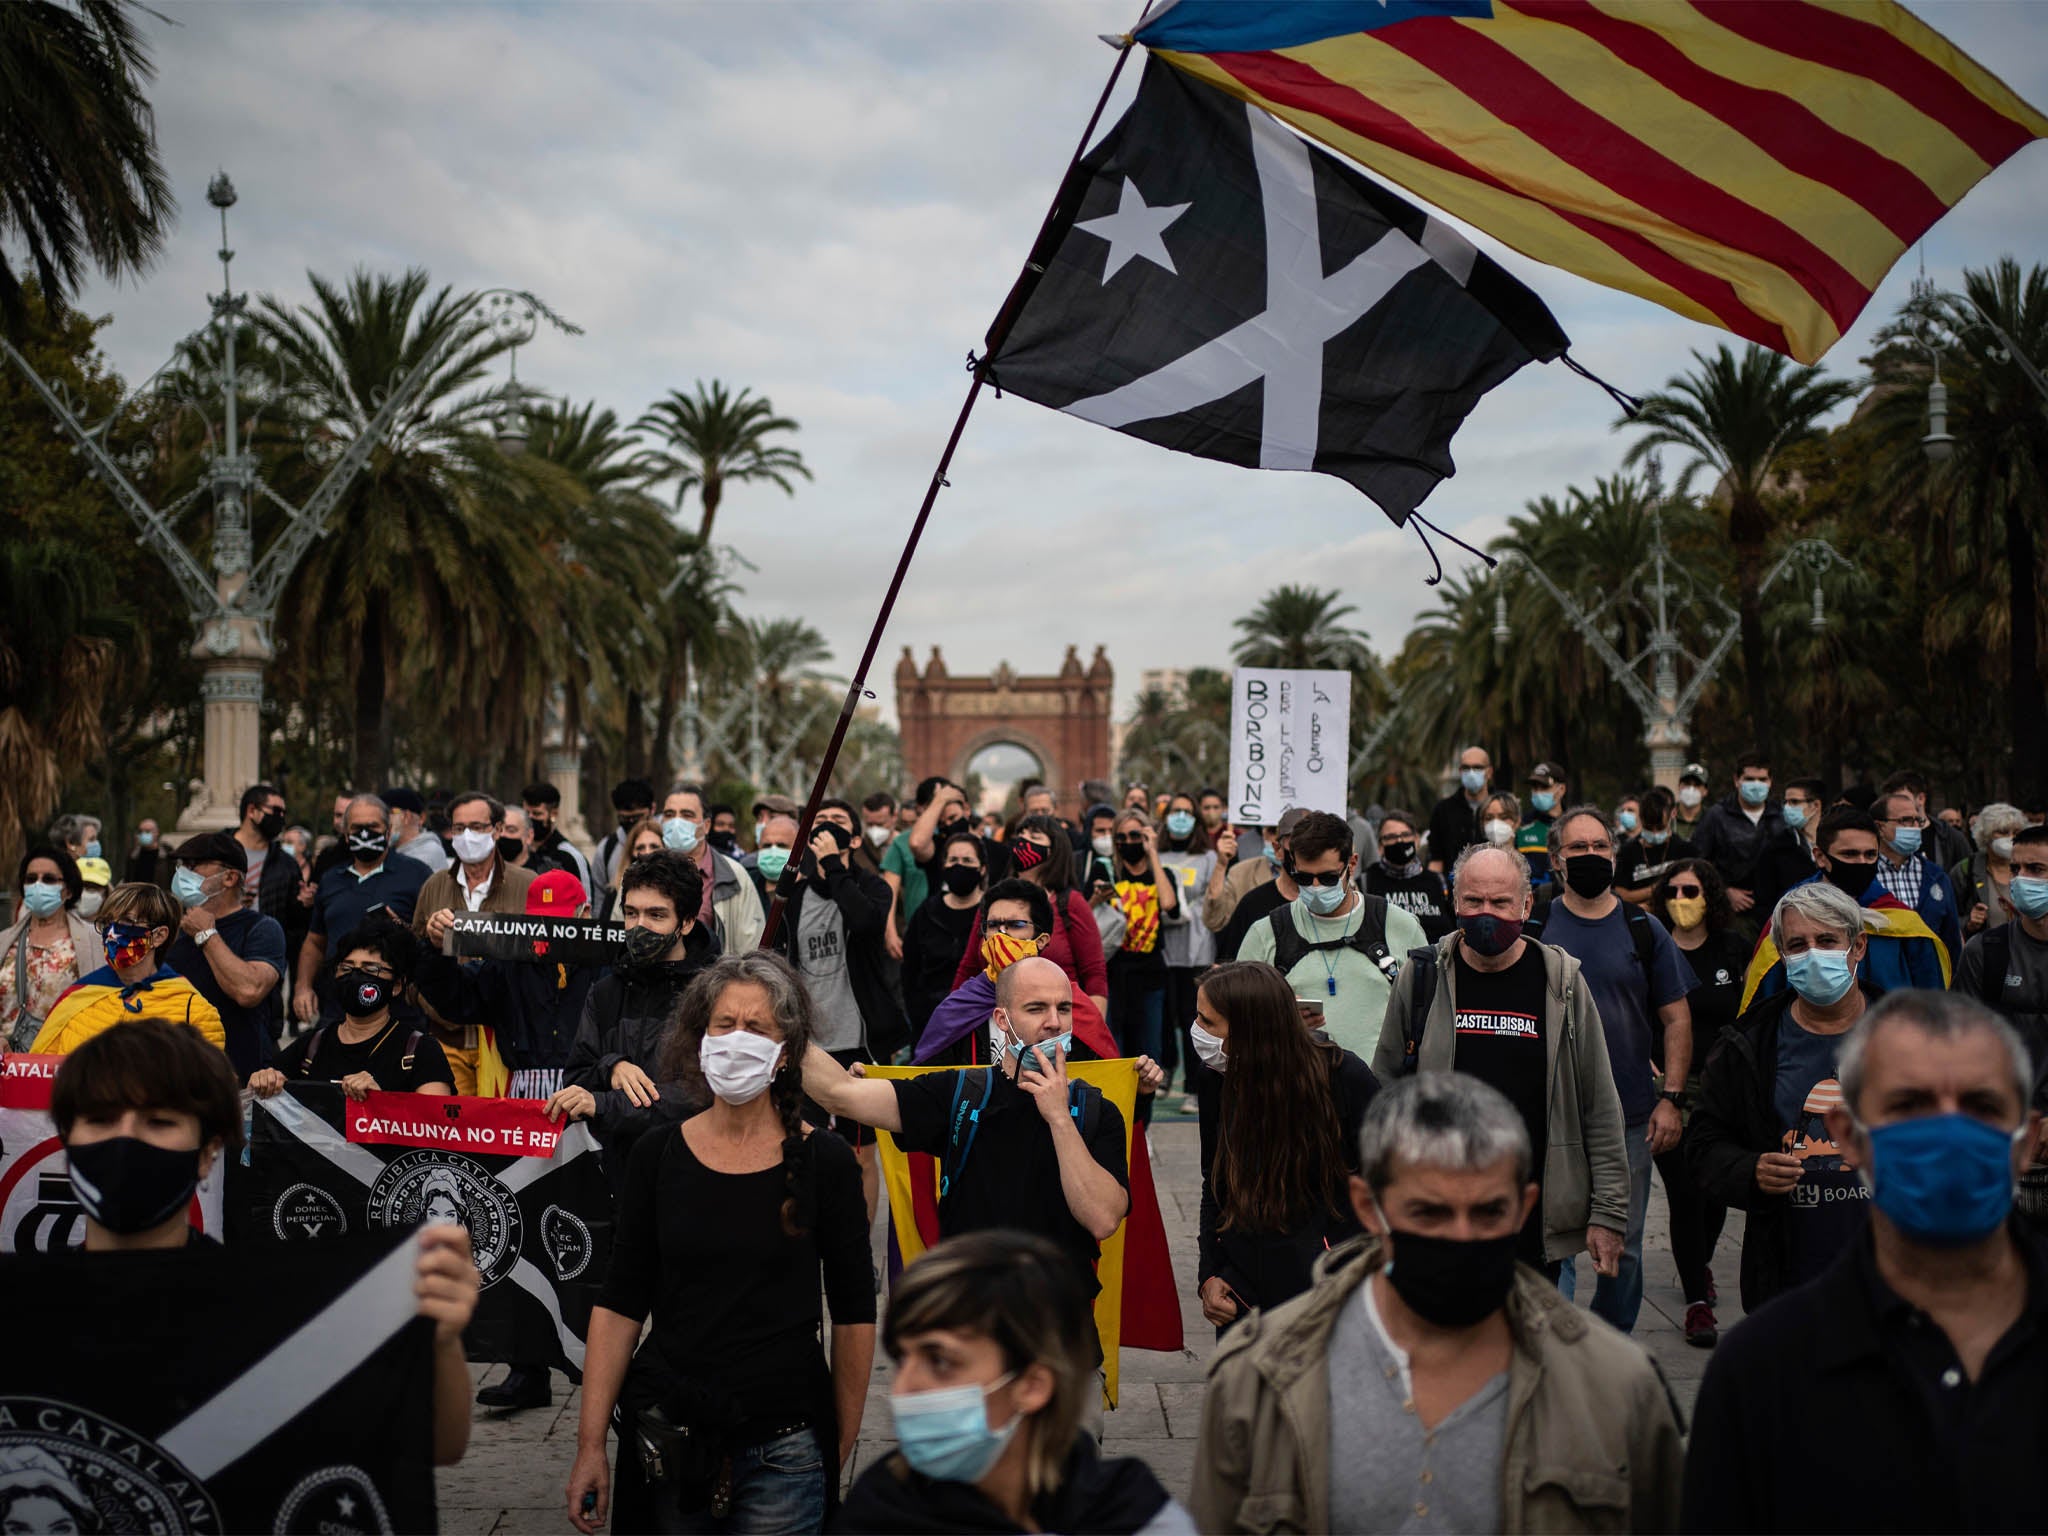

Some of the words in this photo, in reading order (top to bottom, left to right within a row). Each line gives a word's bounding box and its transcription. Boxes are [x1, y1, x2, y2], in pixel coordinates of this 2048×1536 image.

[1239, 680, 1268, 822] BORBONS
[453, 919, 548, 938] CATALUNYA
[553, 925, 577, 939] NO
[582, 925, 602, 941] TÉ
[1455, 1013, 1538, 1035] CASTELLBISBAL
[0, 1062, 60, 1079] ATAL
[354, 1117, 462, 1142] CATALUNYA
[466, 1127, 496, 1144] NO
[499, 1125, 524, 1146] TÉ
[528, 1130, 559, 1149] REI
[447, 1155, 519, 1227] CATALANA
[37, 1408, 210, 1536] CATALAN
